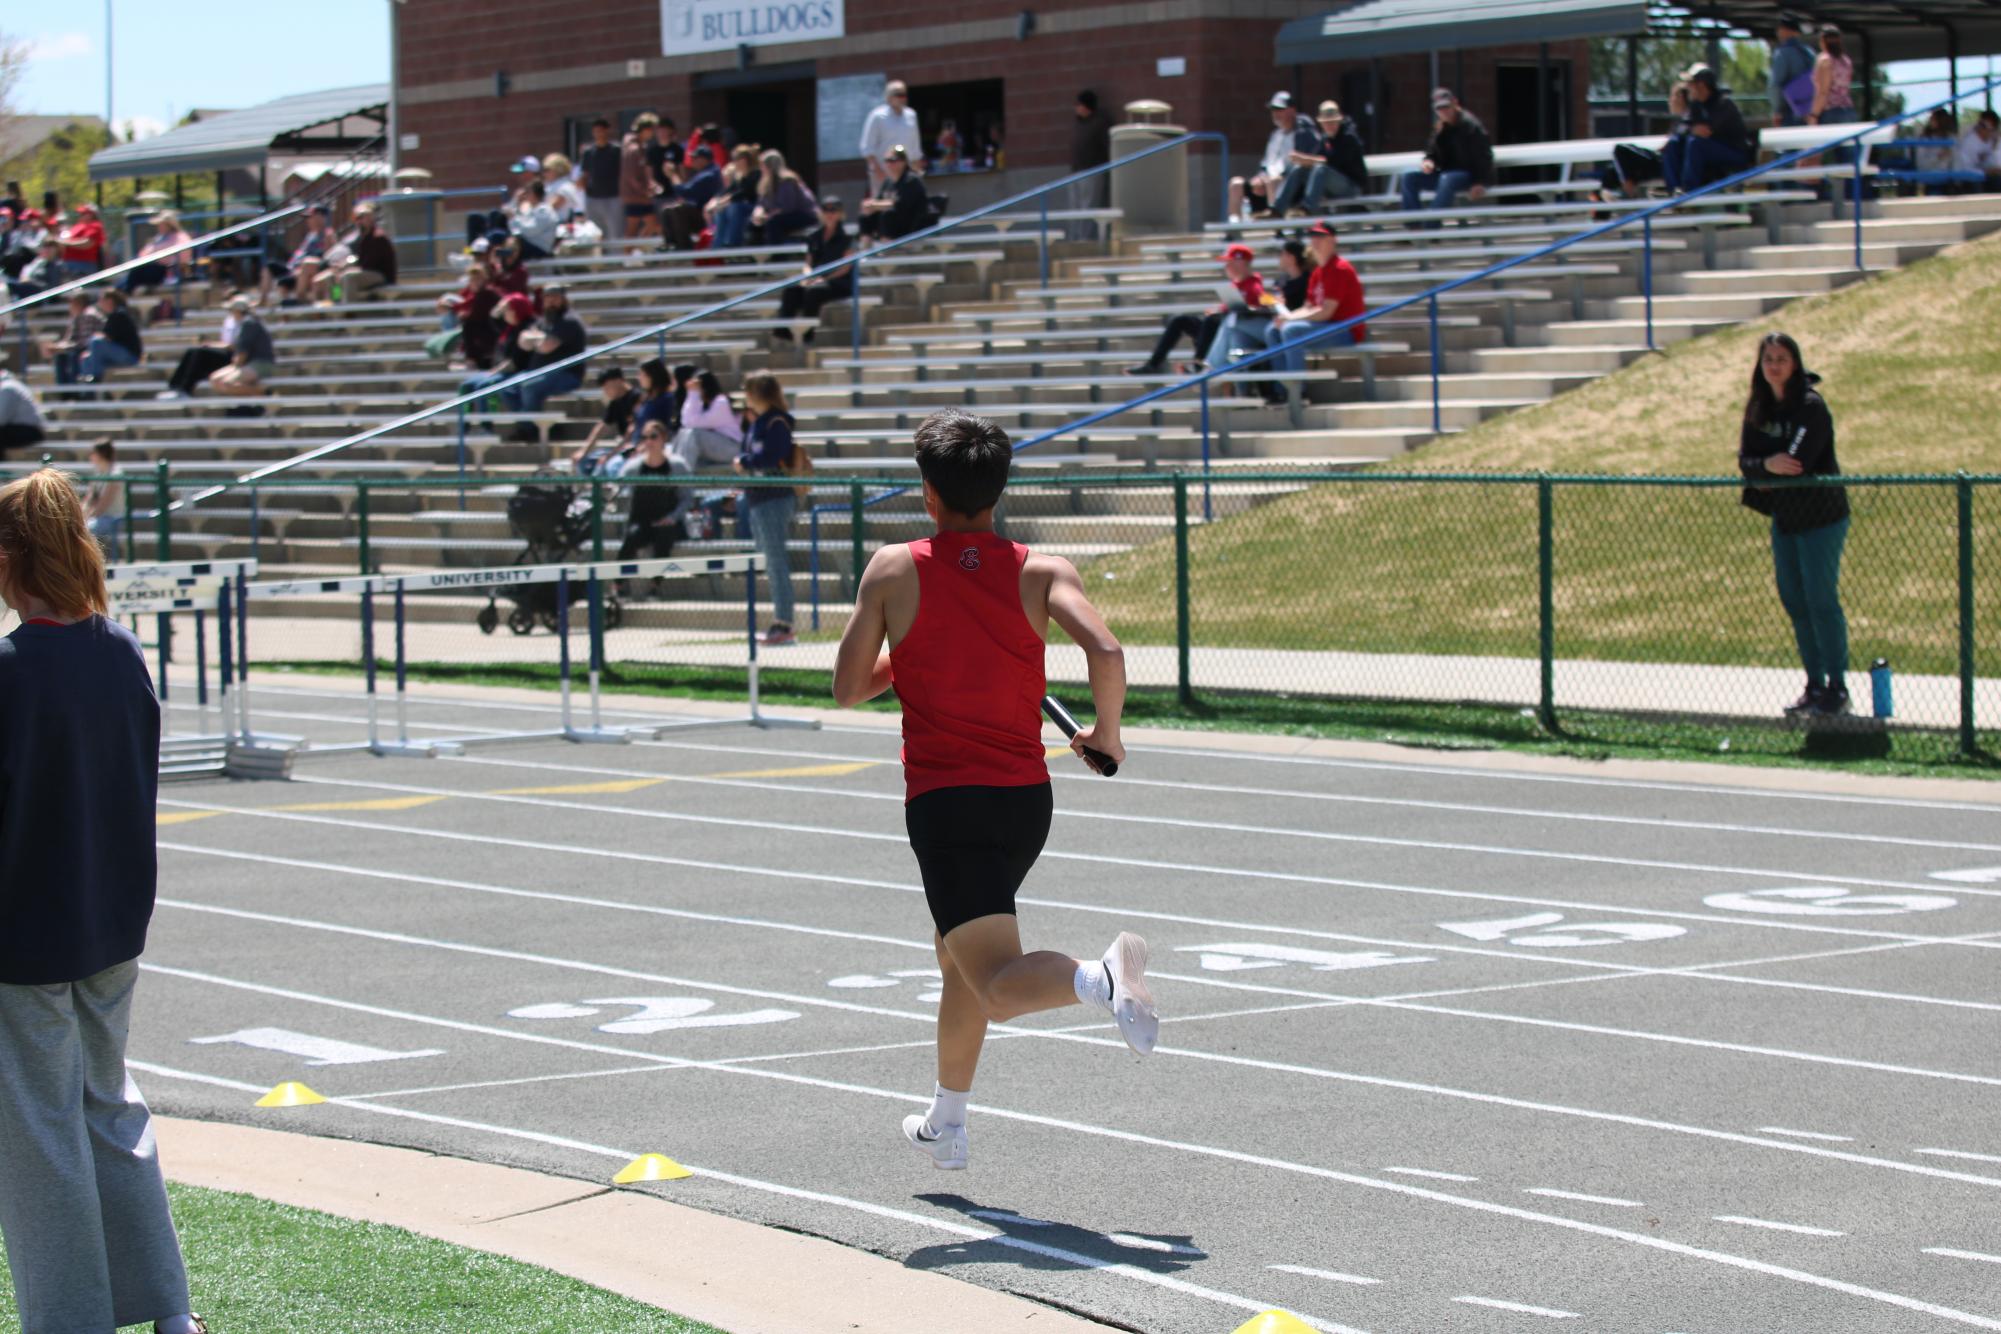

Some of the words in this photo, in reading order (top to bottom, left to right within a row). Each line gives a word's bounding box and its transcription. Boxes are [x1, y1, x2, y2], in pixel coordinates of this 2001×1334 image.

[702, 1, 834, 41] BULLDOGS
[432, 569, 534, 586] UNIVERSITY
[1702, 886, 1957, 915] 6
[1435, 912, 1688, 947] 5
[1173, 942, 1439, 972] 4
[506, 996, 802, 1034] 2
[186, 1026, 447, 1066] 1
